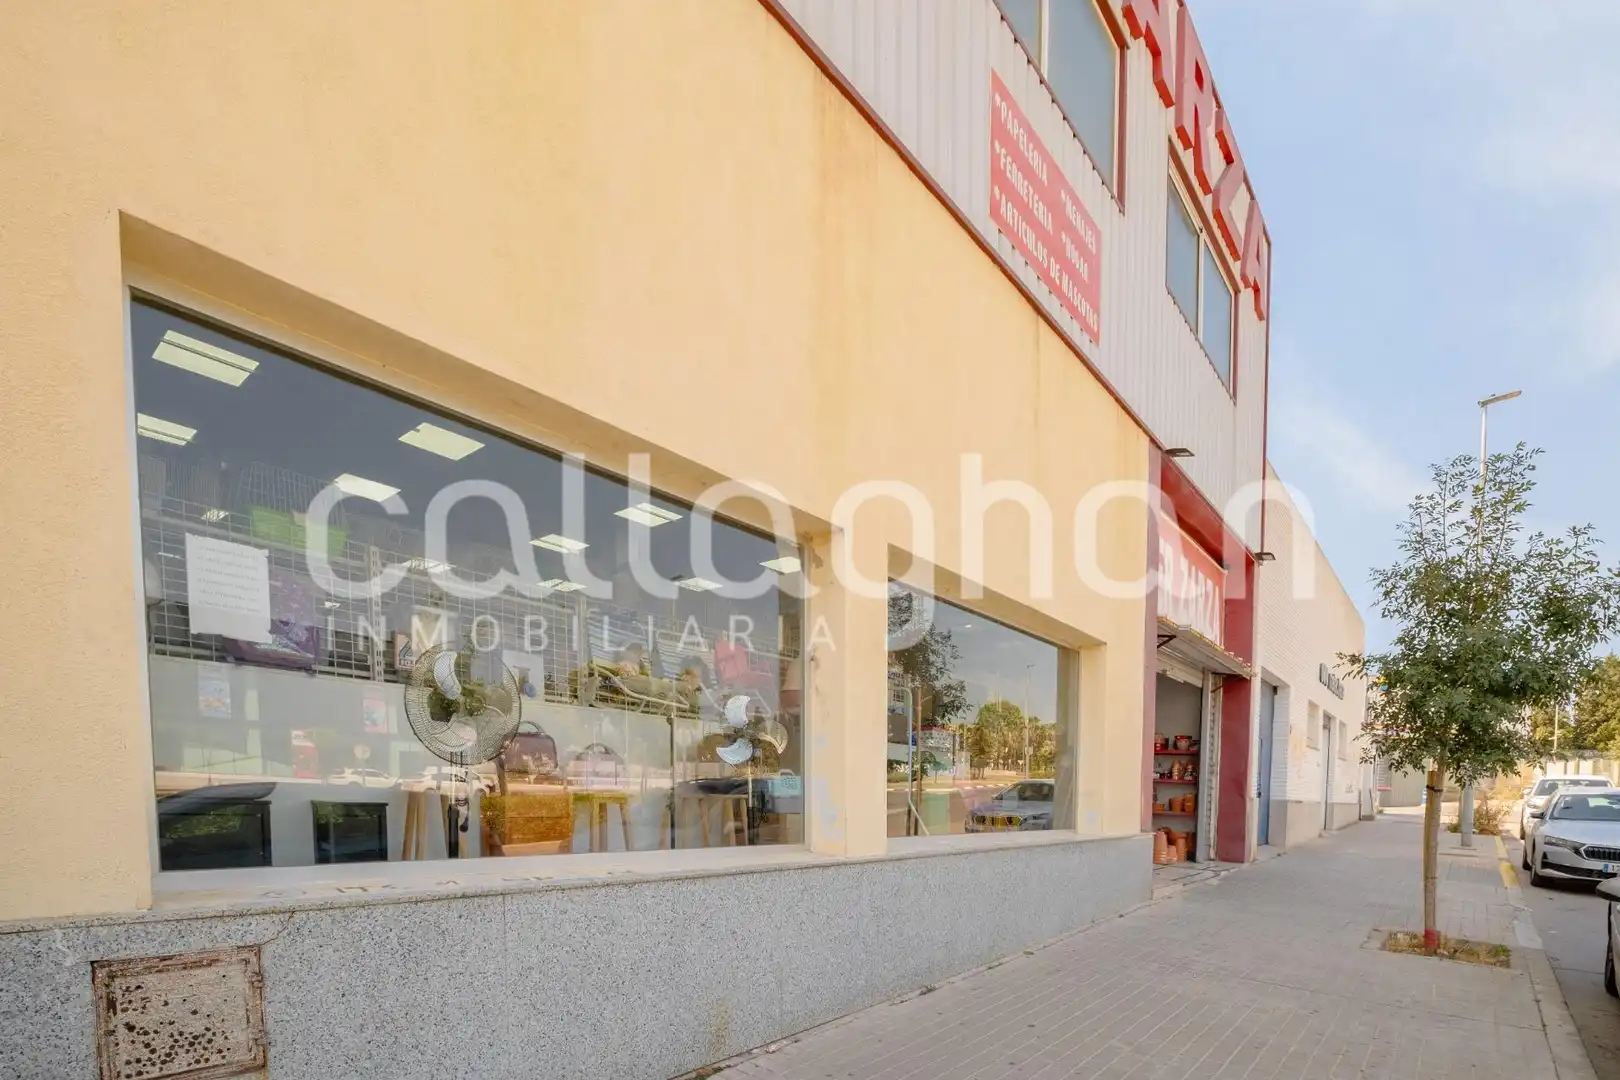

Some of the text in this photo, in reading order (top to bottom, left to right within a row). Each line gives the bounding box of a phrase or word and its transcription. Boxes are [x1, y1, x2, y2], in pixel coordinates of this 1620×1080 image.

[1000, 101, 1048, 187] PAPELERIA
[999, 147, 1054, 236] FERRETERIA
[999, 193, 1099, 333] ARTICULOS DE MASCOTAS
